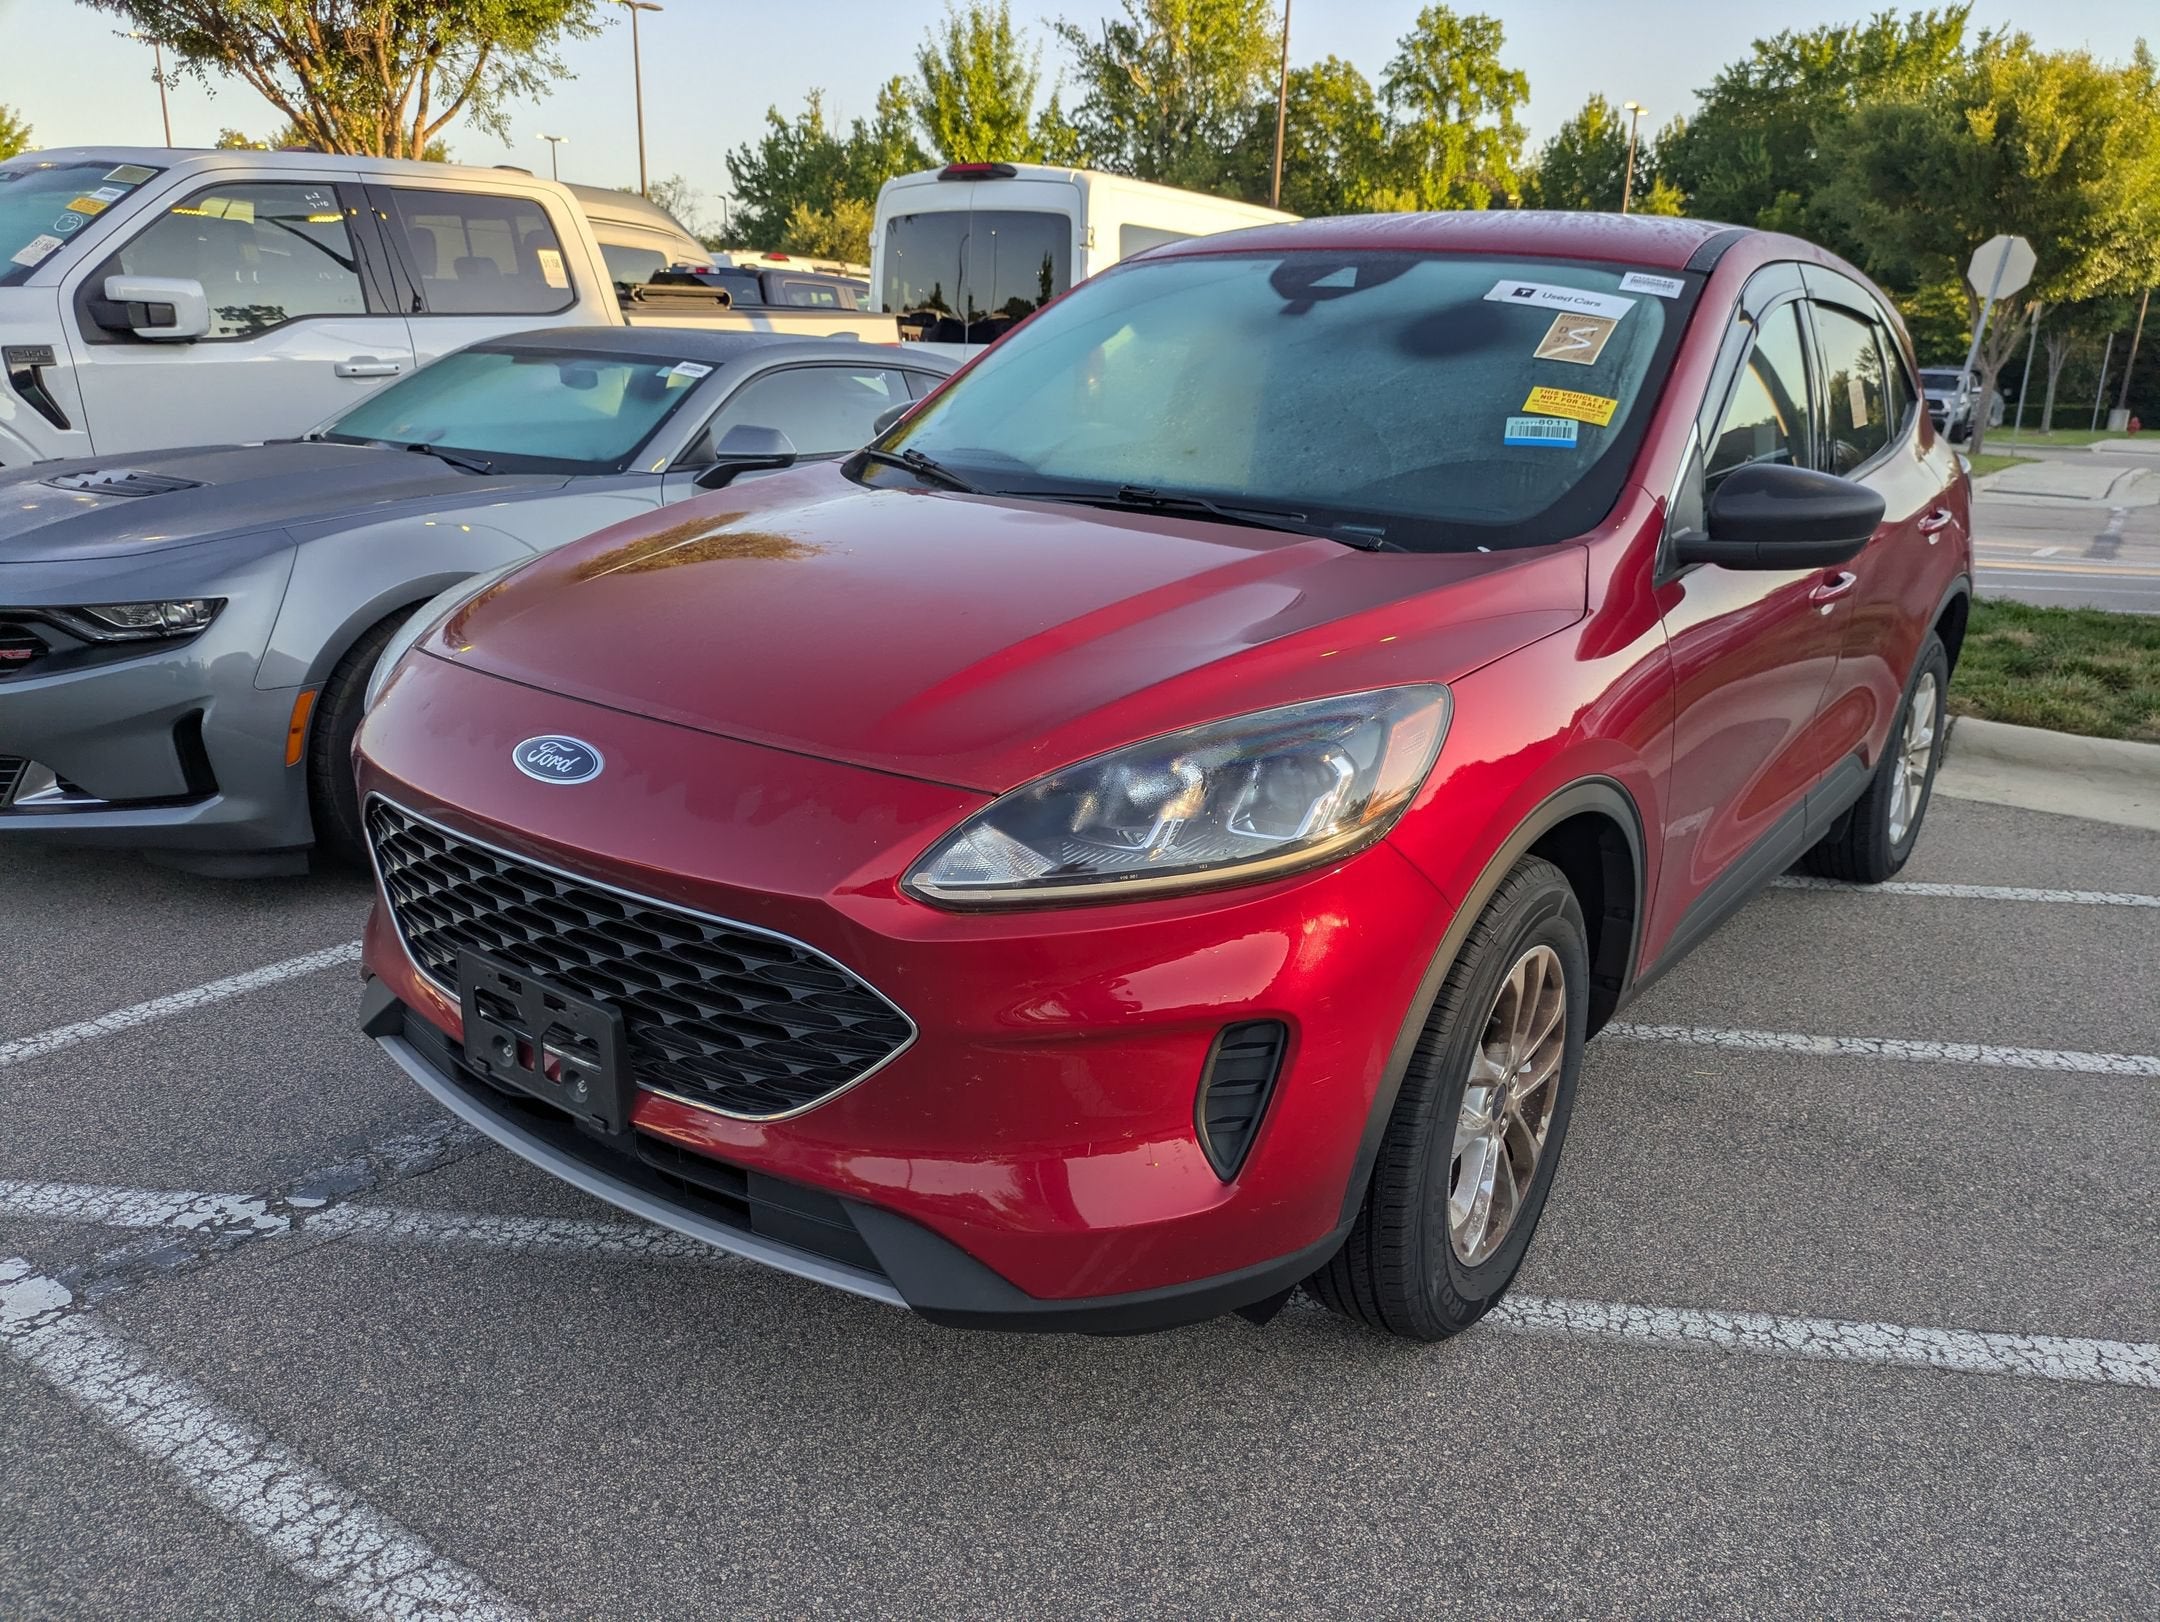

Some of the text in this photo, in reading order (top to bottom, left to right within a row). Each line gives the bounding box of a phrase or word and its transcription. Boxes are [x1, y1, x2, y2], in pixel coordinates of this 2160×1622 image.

[1541, 292, 1573, 303] Used
[1573, 296, 1602, 307] Cars
[1539, 388, 1559, 397] THIS
[1562, 391, 1600, 403] VEHICLE
[1539, 394, 1558, 402] NOT
[1560, 397, 1580, 405] FOR
[1581, 400, 1605, 410] SALE
[527, 741, 582, 773] Ford
